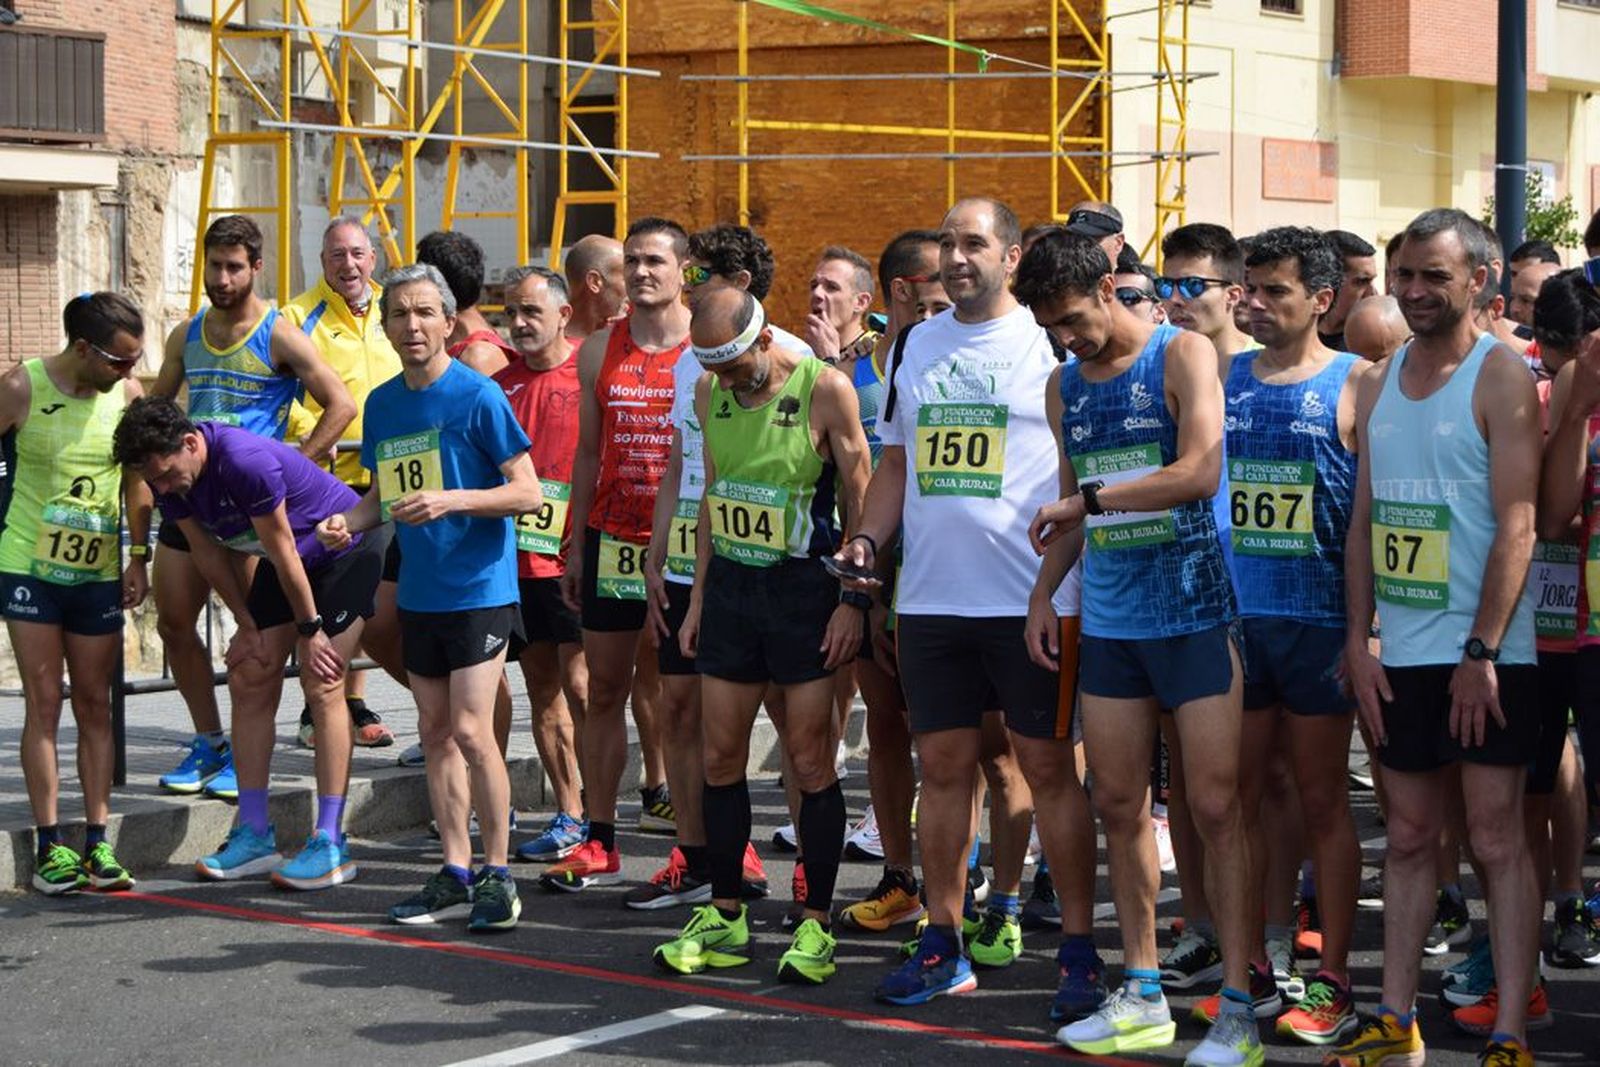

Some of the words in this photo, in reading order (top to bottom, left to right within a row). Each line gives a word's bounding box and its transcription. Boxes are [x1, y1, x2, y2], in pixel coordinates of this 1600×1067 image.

[609, 384, 674, 399] Movijerez
[944, 407, 995, 418] FUNDACION
[943, 416, 962, 425] CAJA
[964, 417, 995, 426] RURAL
[613, 433, 632, 444] SG
[926, 431, 990, 468] 150
[1097, 449, 1148, 464] FUNDACION
[1099, 464, 1118, 475] CAJA
[1119, 460, 1149, 471] RURAL
[1245, 463, 1302, 475] FUNDACION
[394, 459, 424, 493] 18
[934, 477, 957, 488] CAJA
[959, 478, 996, 490] RURAL
[1245, 473, 1267, 482] CAJA
[1270, 474, 1301, 483] RURAL
[728, 482, 778, 498] FUNDACION
[729, 491, 746, 501] CAJA
[1231, 490, 1304, 530] 667
[1386, 506, 1437, 519] FUNDACION
[717, 503, 774, 542] 104
[1387, 516, 1404, 526] CAJA
[1406, 517, 1437, 528] RURAL
[1108, 529, 1131, 541] CAJA
[1132, 525, 1168, 539] RURAL
[48, 530, 103, 565] 136
[1242, 536, 1268, 548] CAJA
[1270, 538, 1308, 549] RURAL
[732, 547, 752, 557] CAJA
[1385, 532, 1423, 574] 67
[1386, 584, 1405, 597] CAJA
[1407, 586, 1442, 600] RURAL
